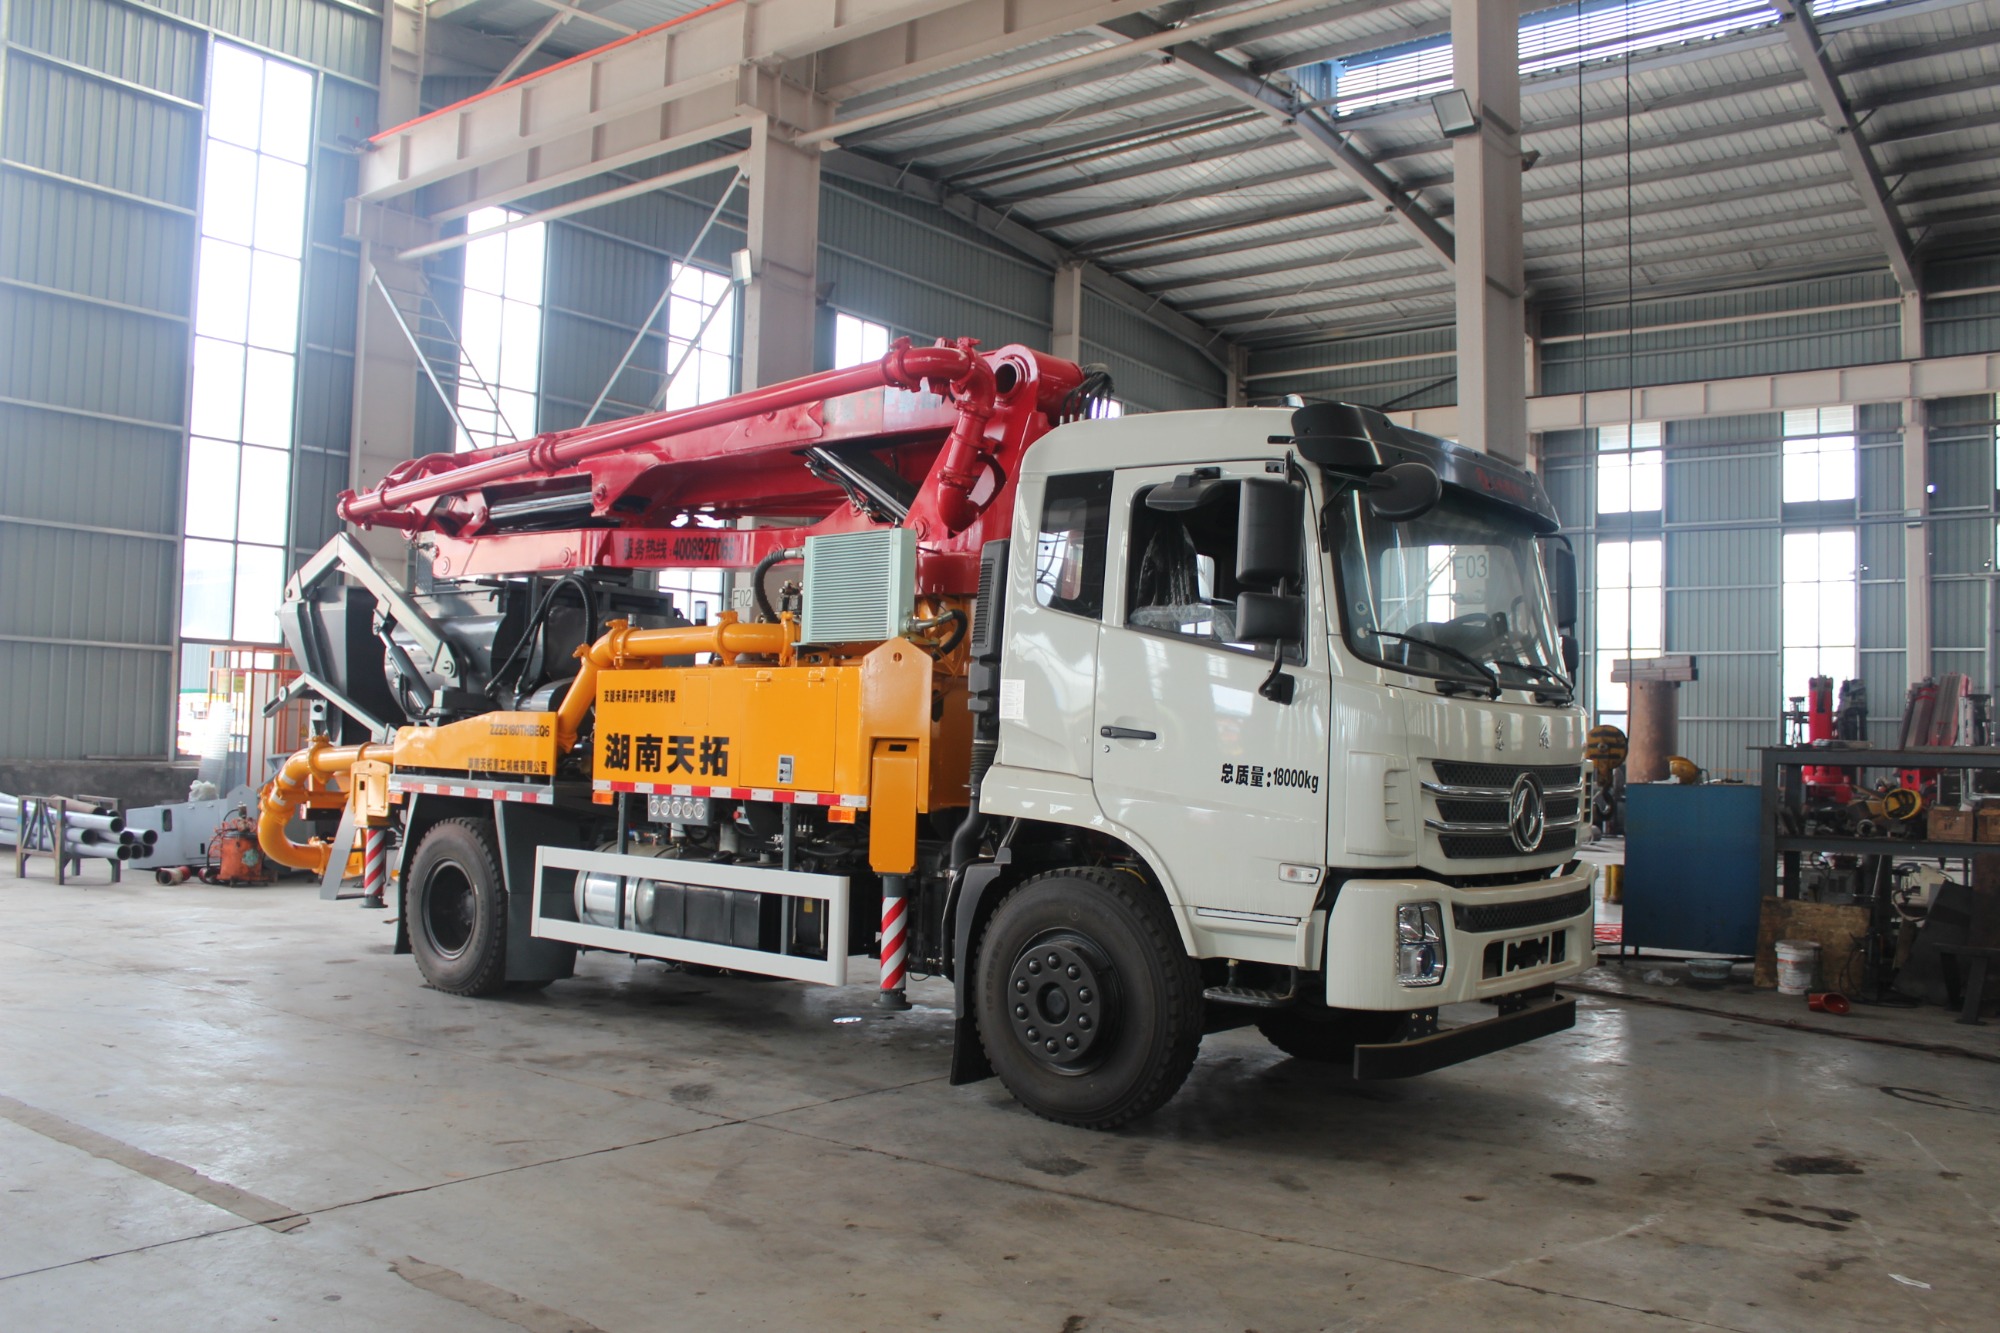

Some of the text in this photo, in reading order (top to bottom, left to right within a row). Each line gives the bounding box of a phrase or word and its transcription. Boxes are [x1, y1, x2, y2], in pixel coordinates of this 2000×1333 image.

[1453, 554, 1487, 578] F03
[732, 589, 752, 607] F02
[604, 733, 729, 776] 湖南天拓
[1221, 763, 1319, 793] 总质量:18000kg
